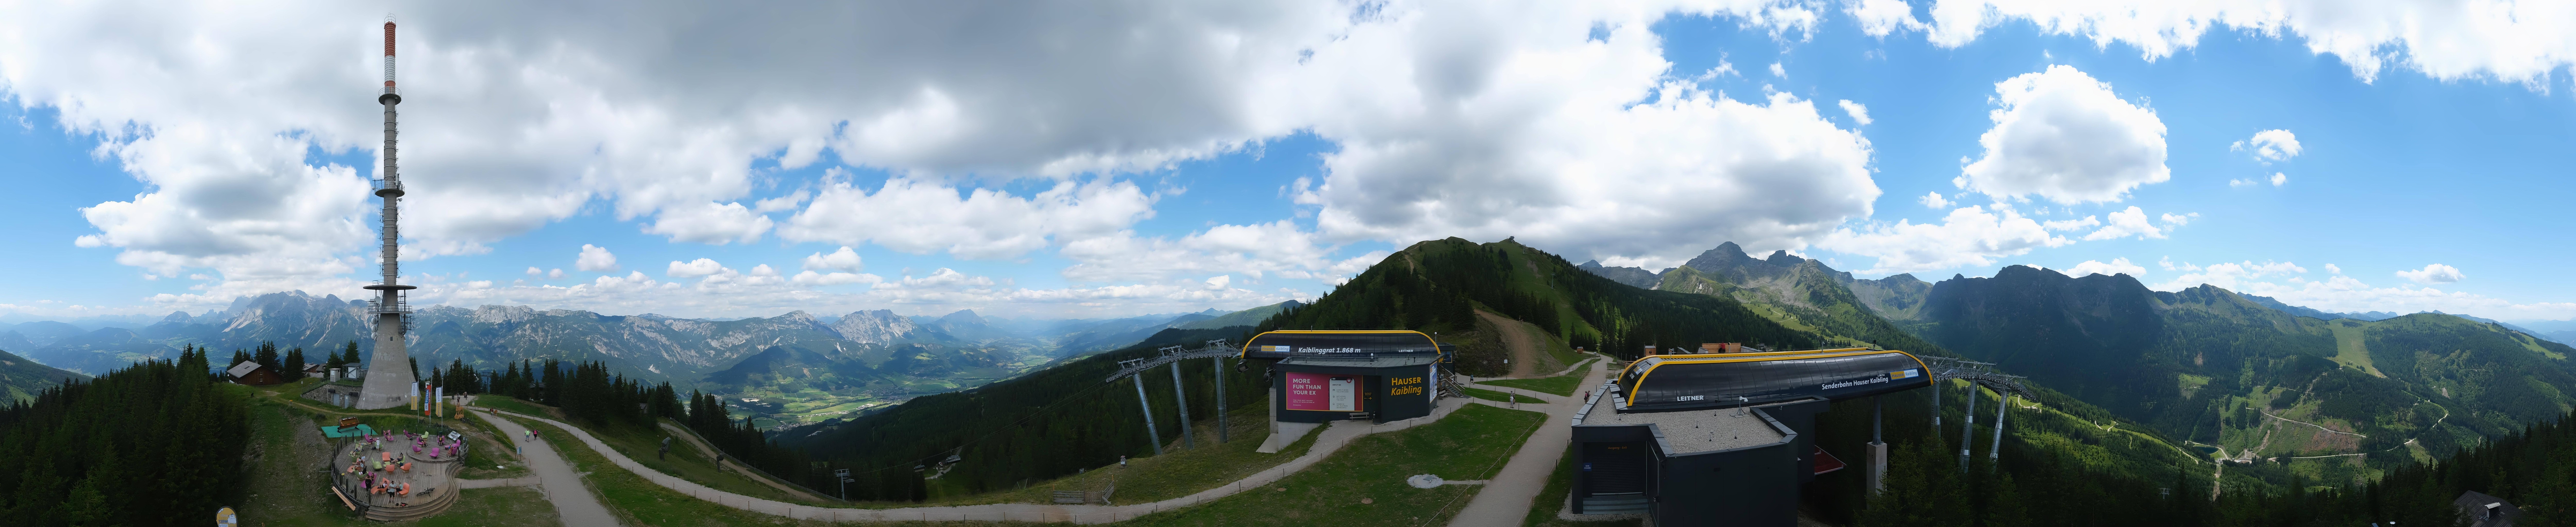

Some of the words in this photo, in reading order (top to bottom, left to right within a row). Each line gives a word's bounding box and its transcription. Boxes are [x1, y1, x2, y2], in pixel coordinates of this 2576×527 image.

[1392, 377, 1421, 386] HAUSER
[1822, 381, 1852, 390] Senderbahn
[1391, 386, 1422, 396] Kaibling
